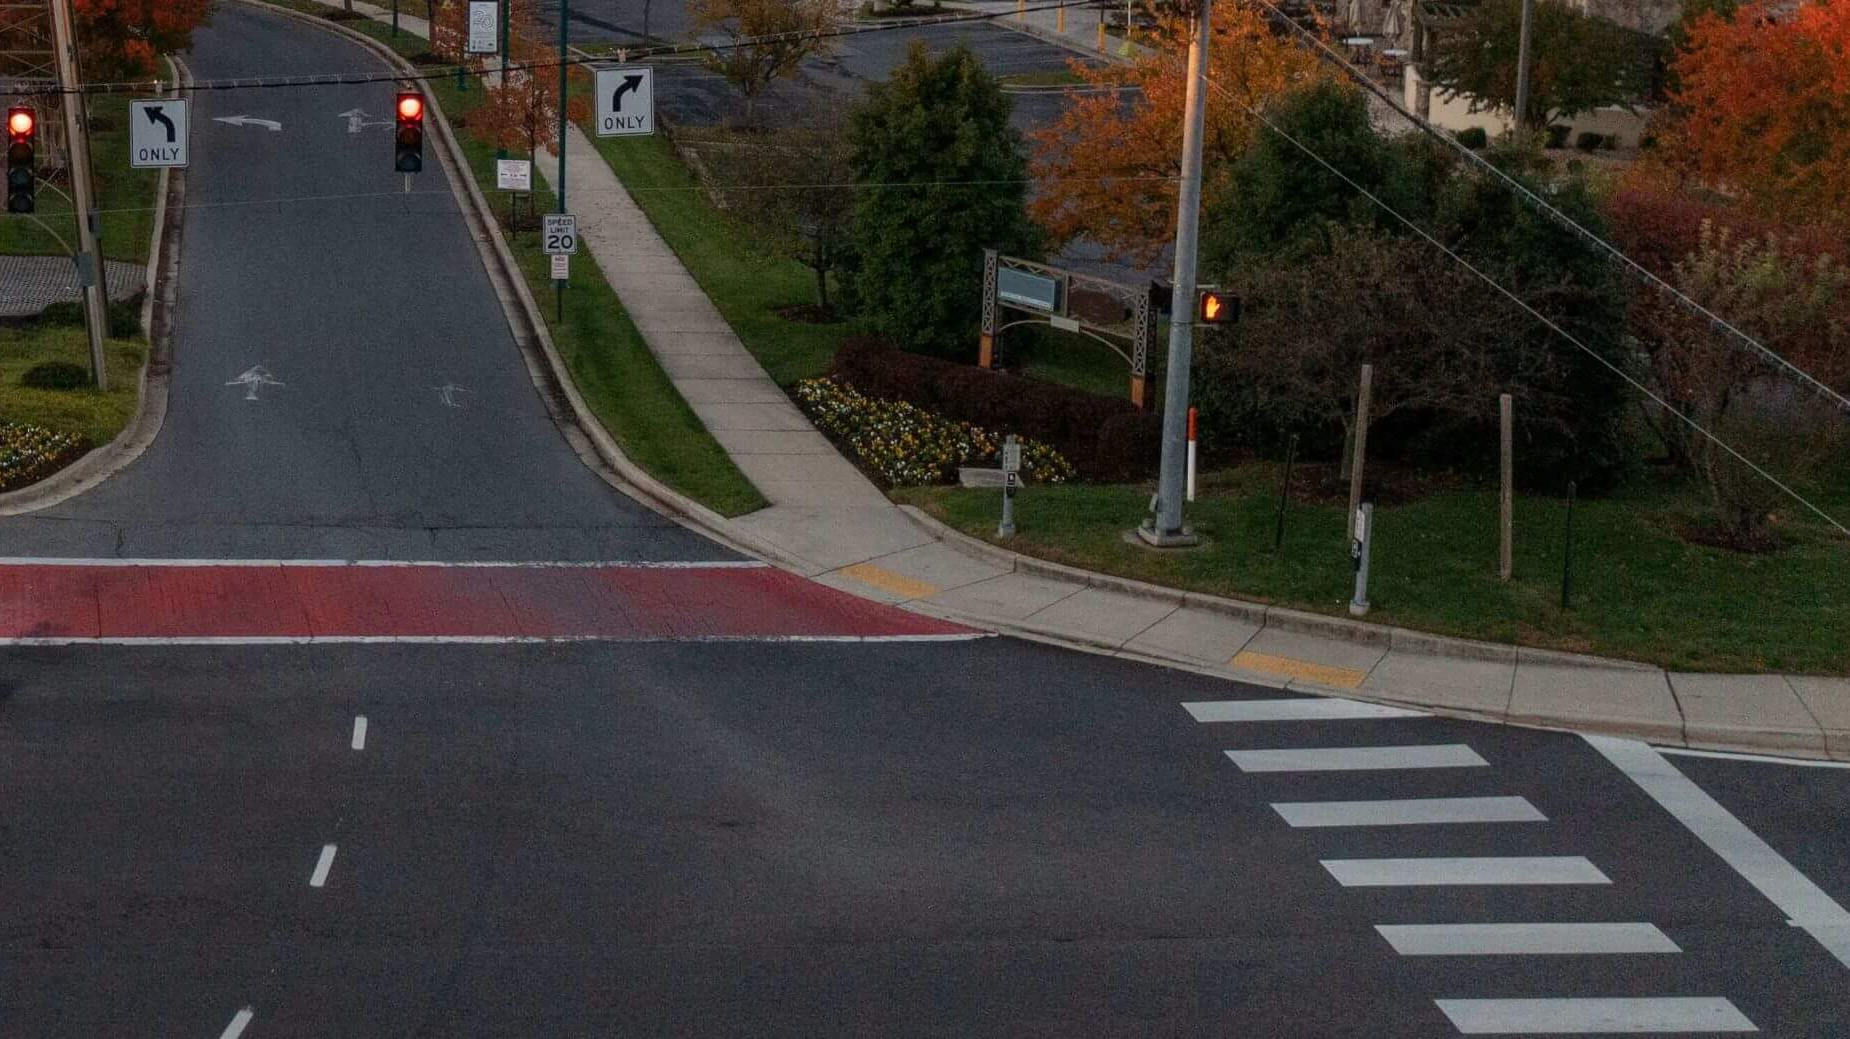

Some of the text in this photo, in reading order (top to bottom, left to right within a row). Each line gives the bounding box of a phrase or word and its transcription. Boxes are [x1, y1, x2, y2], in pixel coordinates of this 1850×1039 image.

[604, 116, 645, 130] ONLY
[139, 147, 179, 161] ONLY
[547, 235, 573, 249] 20
